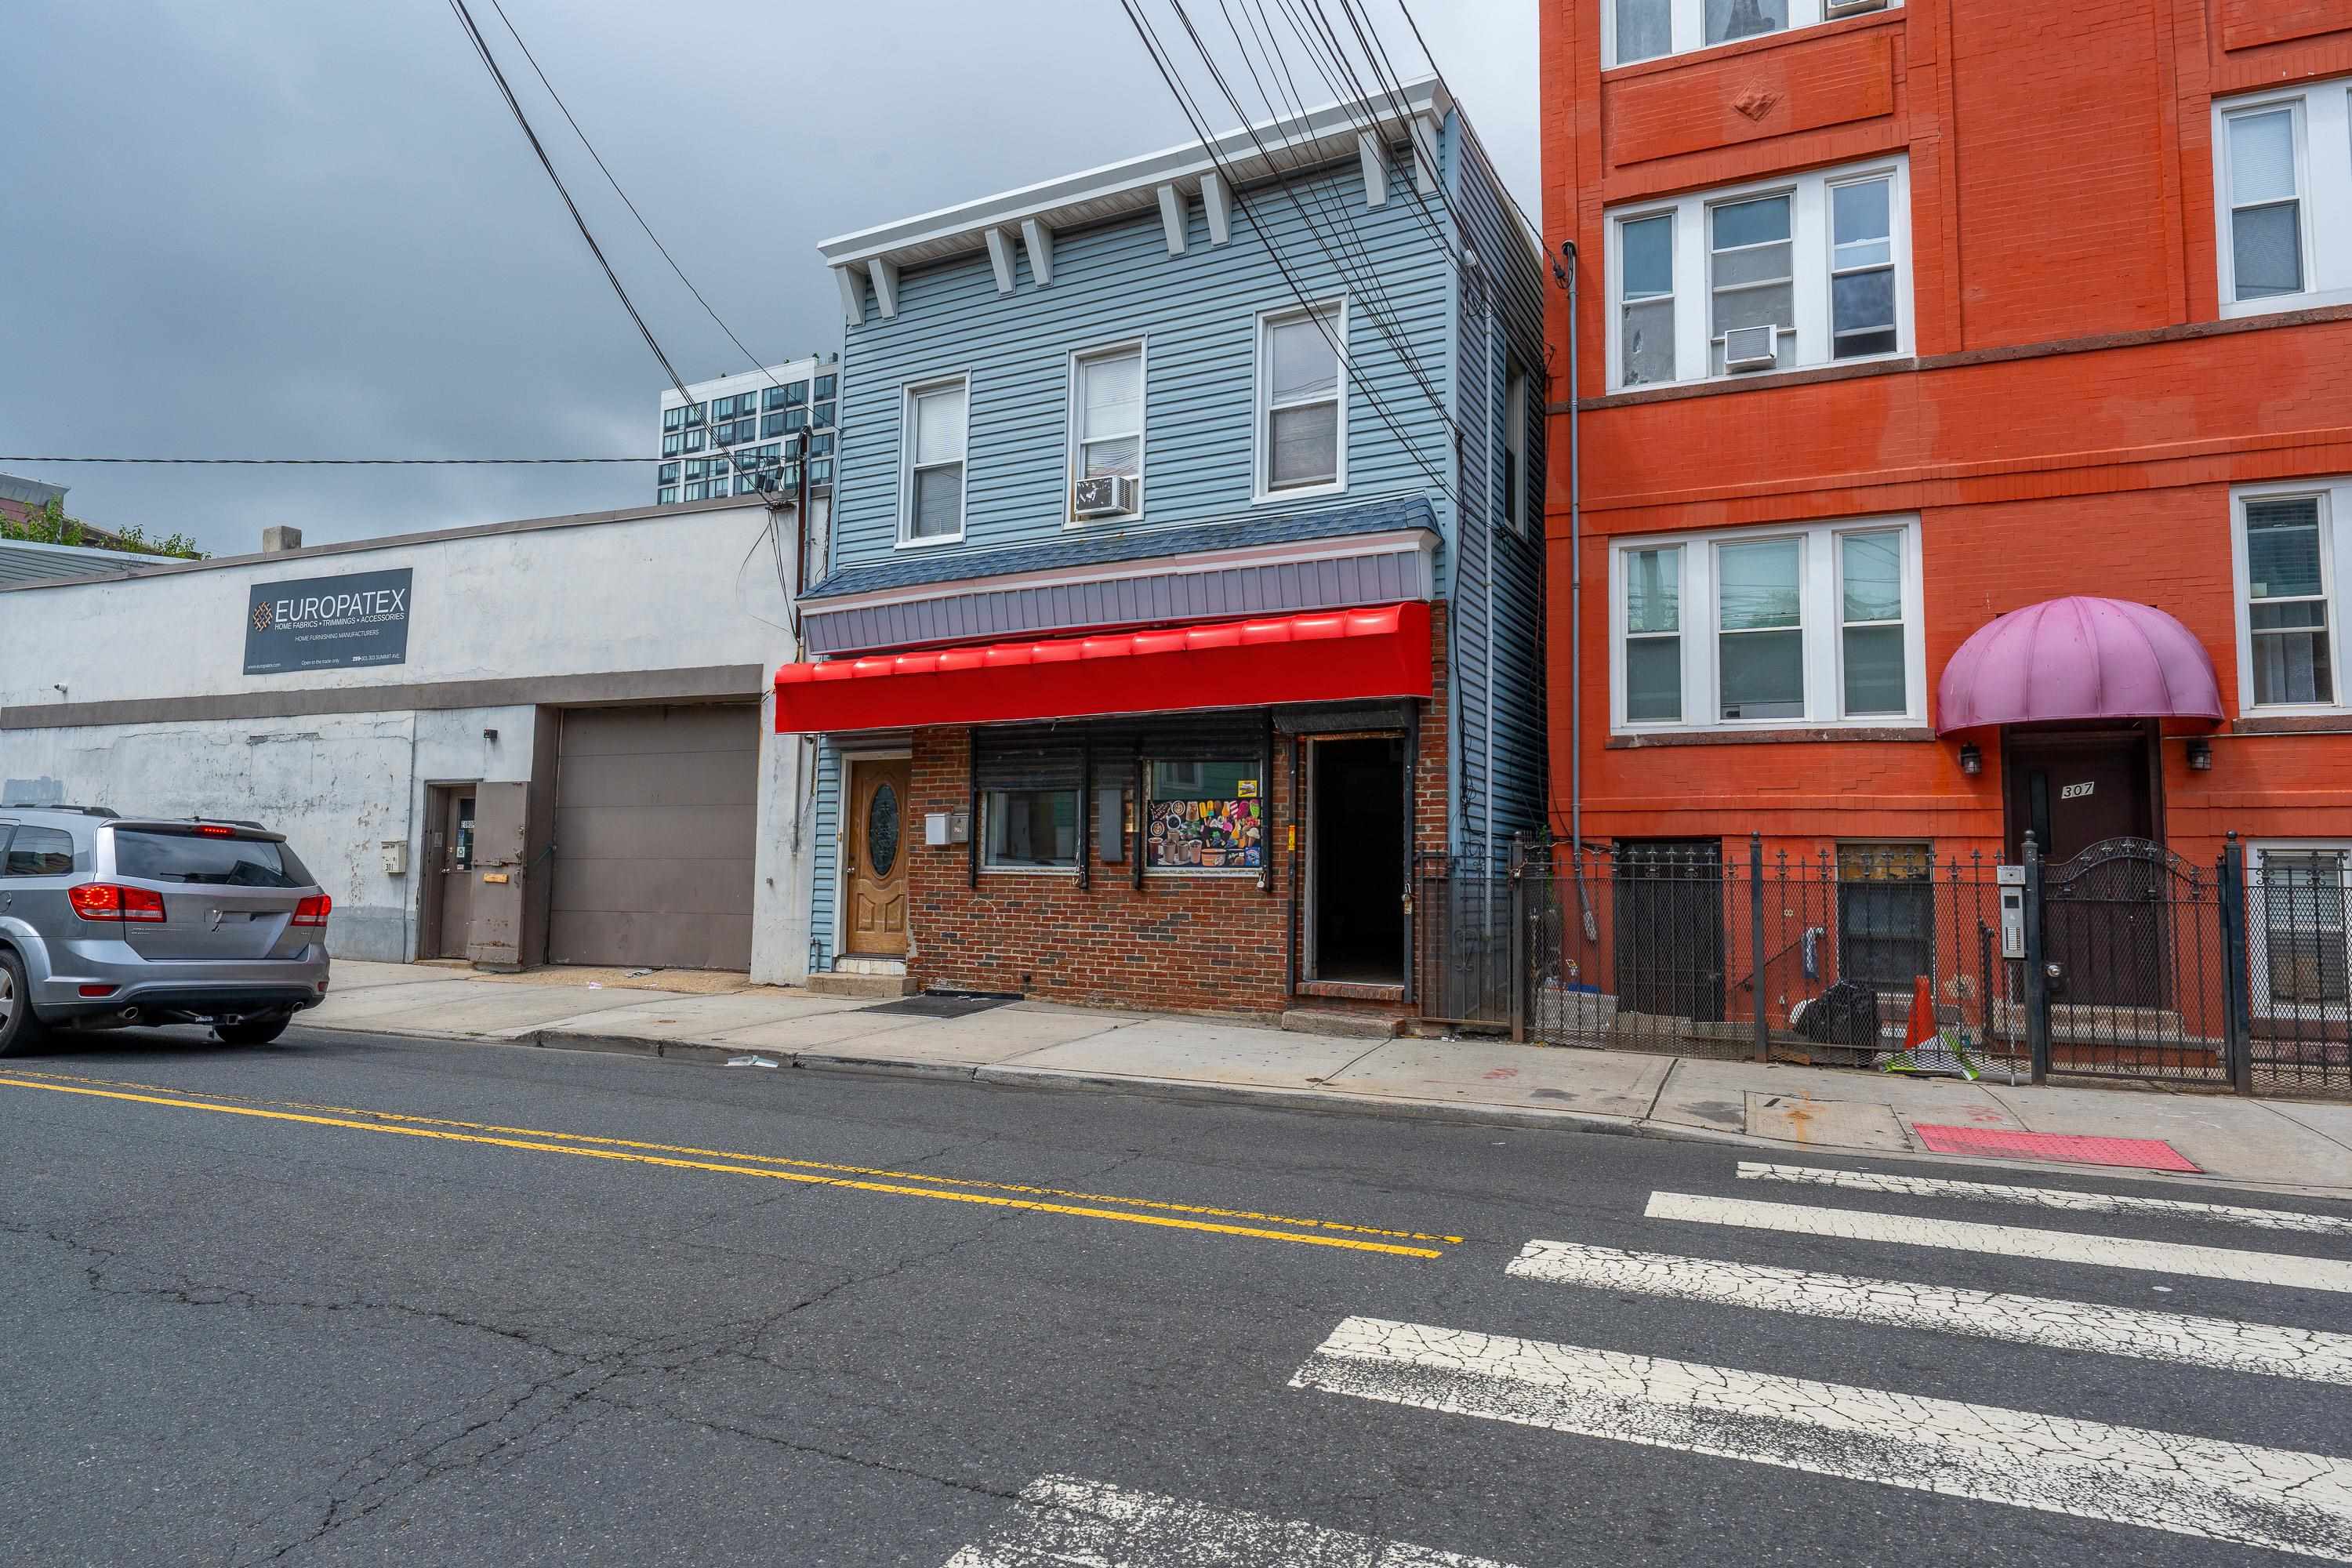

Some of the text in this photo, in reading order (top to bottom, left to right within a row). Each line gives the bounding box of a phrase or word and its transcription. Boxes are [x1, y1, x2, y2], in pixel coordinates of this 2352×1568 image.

[275, 588, 405, 622] EUROPATEX
[322, 617, 356, 626] TRIMMINGS
[361, 613, 405, 622] ACCESSORIES
[338, 630, 379, 638] MANUFACTURERS
[2063, 783, 2093, 797] 307
